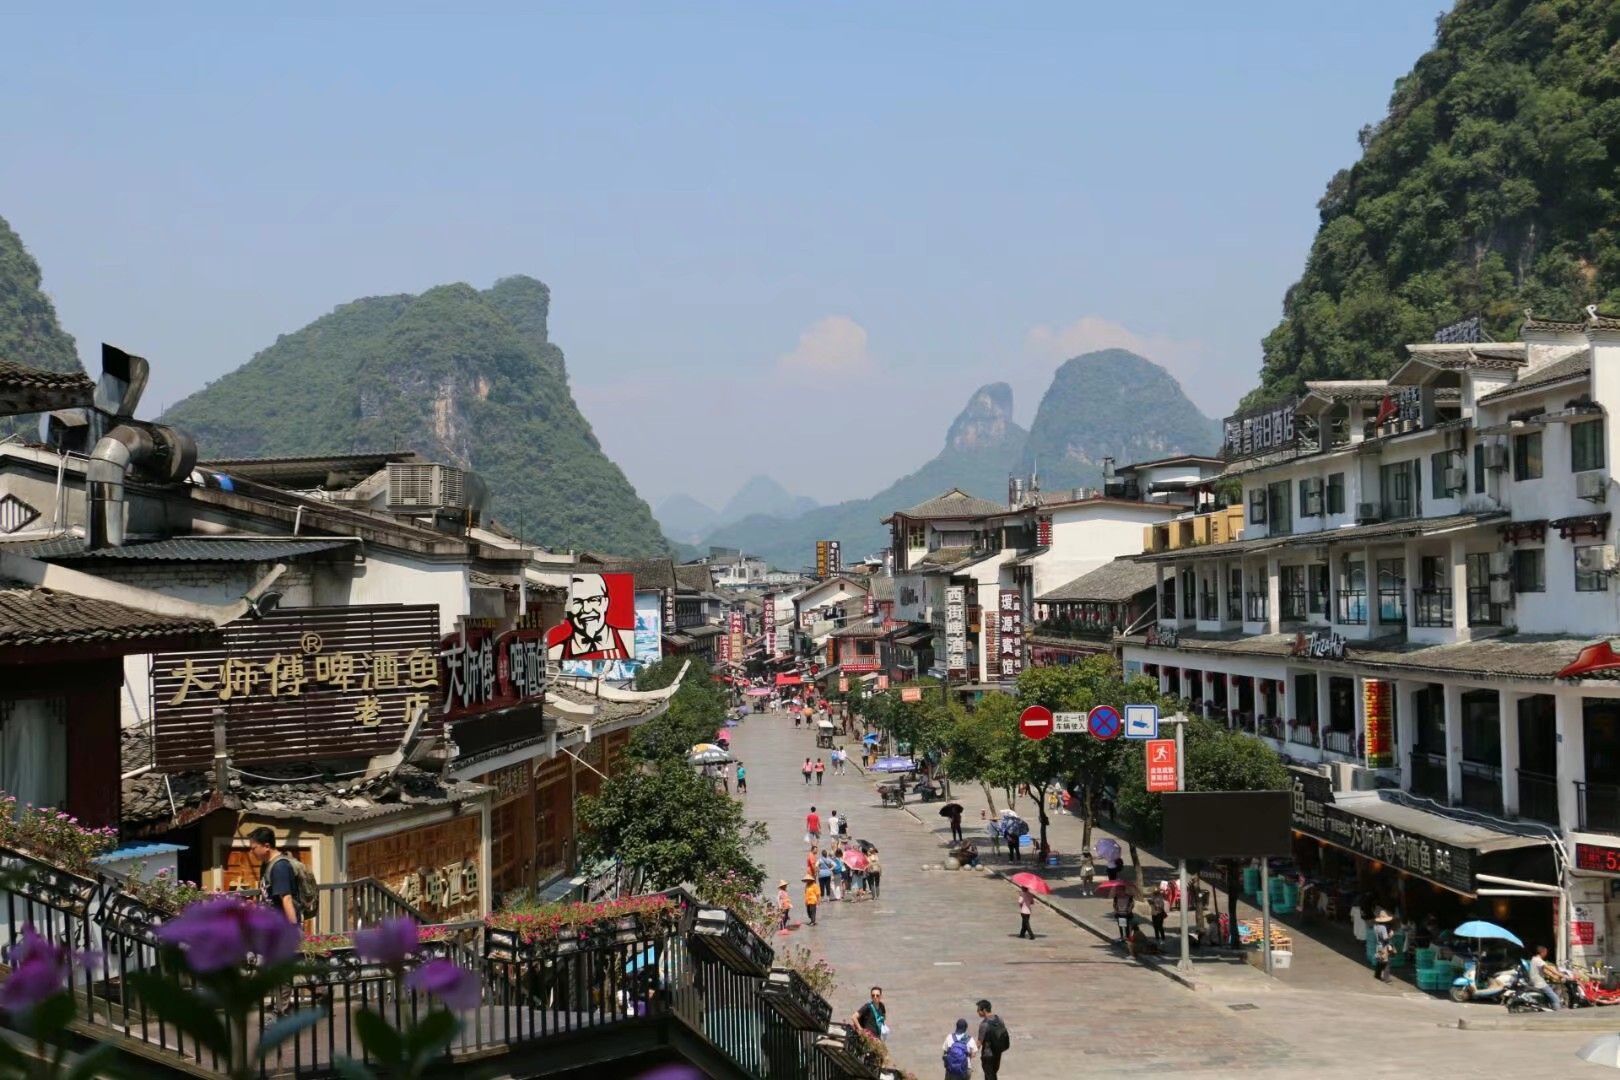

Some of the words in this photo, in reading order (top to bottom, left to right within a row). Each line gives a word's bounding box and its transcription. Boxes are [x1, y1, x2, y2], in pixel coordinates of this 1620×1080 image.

[946, 588, 965, 669] 西街啤酒鱼
[167, 649, 438, 706] 大师傅啤酒鱼
[443, 636, 495, 713] 大师傅
[510, 636, 547, 701] 啤酒鱼
[354, 693, 430, 727] 老店
